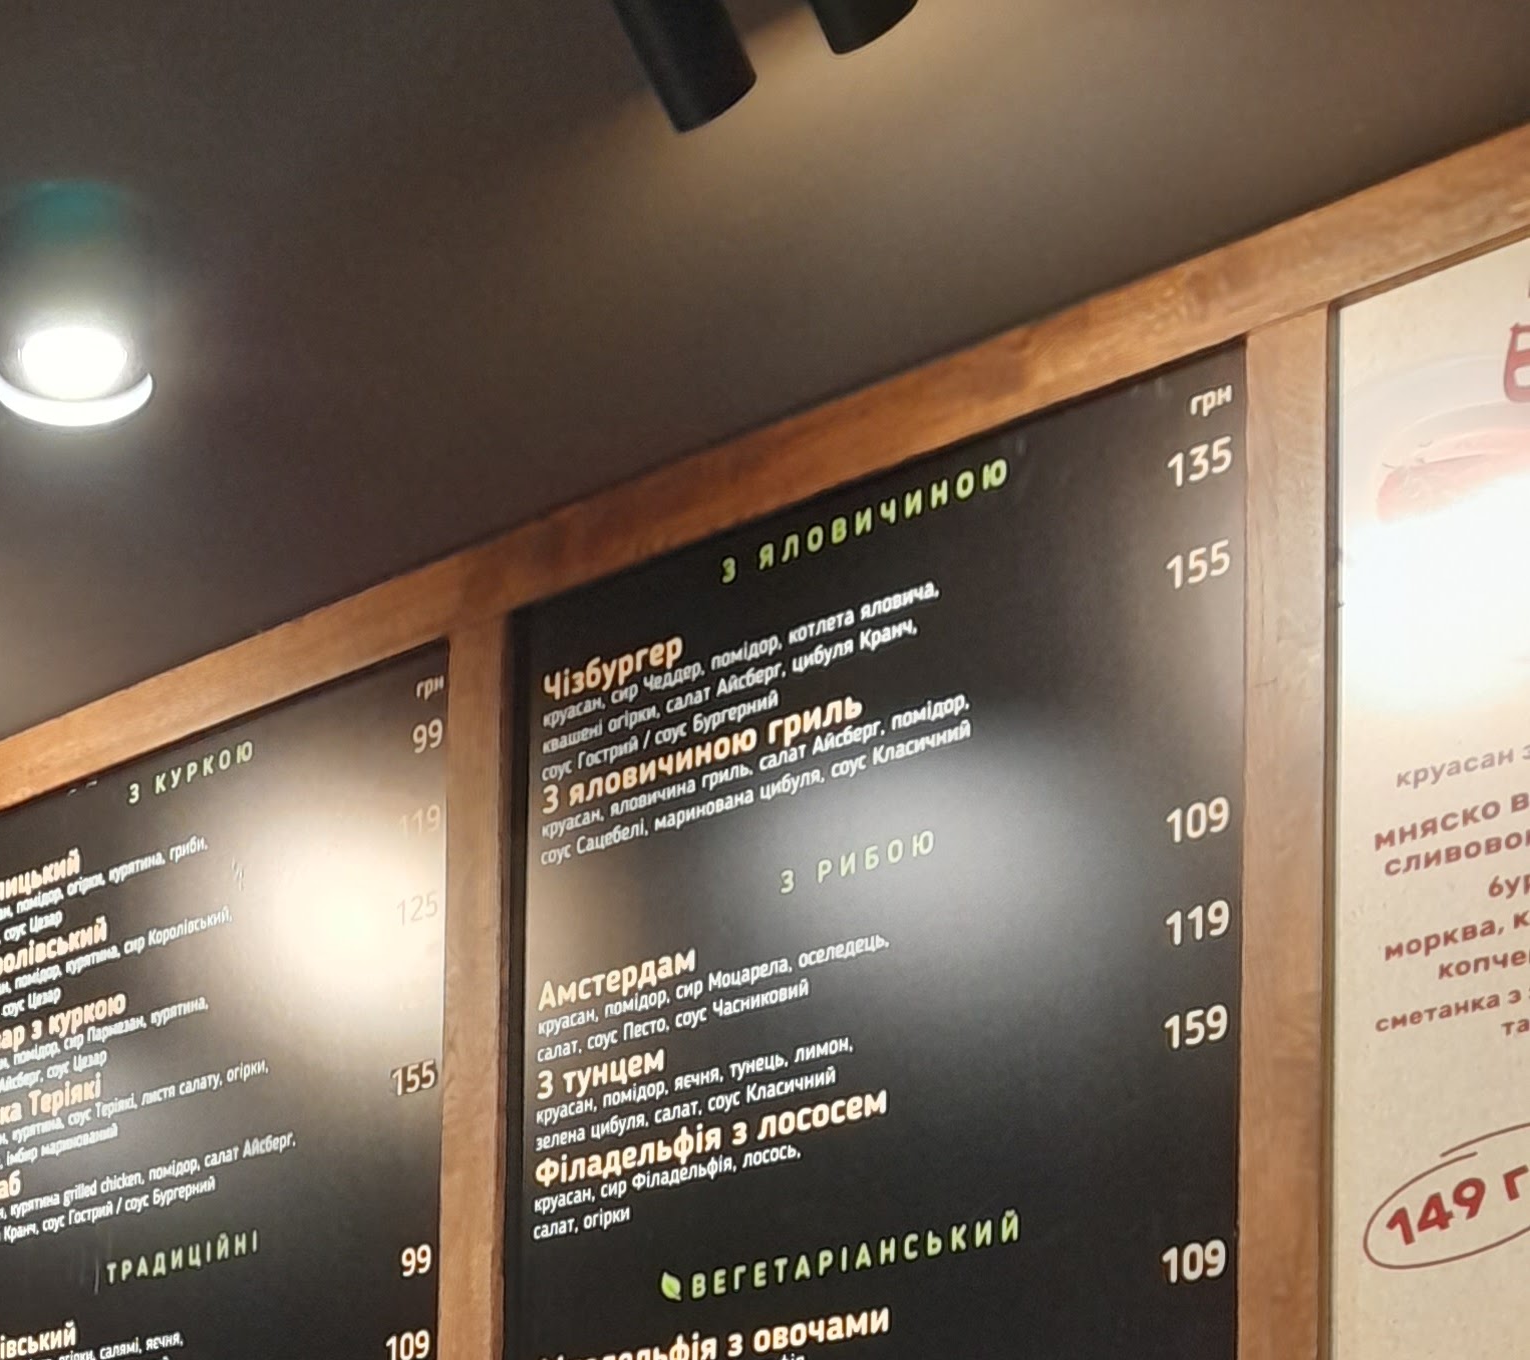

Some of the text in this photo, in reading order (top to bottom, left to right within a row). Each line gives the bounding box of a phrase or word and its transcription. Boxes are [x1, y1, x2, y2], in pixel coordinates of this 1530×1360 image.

[1190, 384, 1232, 417] грн
[1167, 436, 1232, 487] 135
[722, 459, 1007, 583] З ЯЛОВИЧИНОЮ
[1166, 539, 1230, 589] 155
[416, 677, 444, 701] грн
[544, 636, 683, 700] Чізбургер
[413, 719, 444, 753] 99
[542, 760, 573, 781] соус
[577, 735, 639, 770] Гострий
[654, 722, 687, 745] соус
[692, 689, 779, 734] Бургерний
[542, 696, 863, 814] З яловичиною гриль
[128, 741, 254, 805] З КУРКОЮ
[1396, 750, 1514, 788] круасан
[1166, 797, 1229, 843] 109
[780, 830, 934, 894] З РИБОЮ
[1165, 900, 1230, 946] 119
[1383, 917, 1504, 962] морква,
[538, 948, 696, 1011] Амстердам
[31, 1019, 43, 1040] з
[48, 993, 126, 1039] куркою
[1164, 1004, 1228, 1049] 159
[1374, 991, 1501, 1034] сметанка
[28, 1071, 101, 1117] Теріякі
[392, 1062, 437, 1096] 155
[537, 1048, 664, 1100] З тунцем
[535, 1089, 887, 1188] Філадельфія з лососем
[1386, 1176, 1486, 1247] 149
[106, 1230, 257, 1284] ТРАДИЦІЙНІ
[401, 1244, 432, 1277] 99
[692, 1209, 1018, 1299] ВЕГЕТАРІАНСЬКИЙ
[1162, 1239, 1226, 1283] 109
[727, 1333, 743, 1357] з
[753, 1307, 889, 1353] овочами
